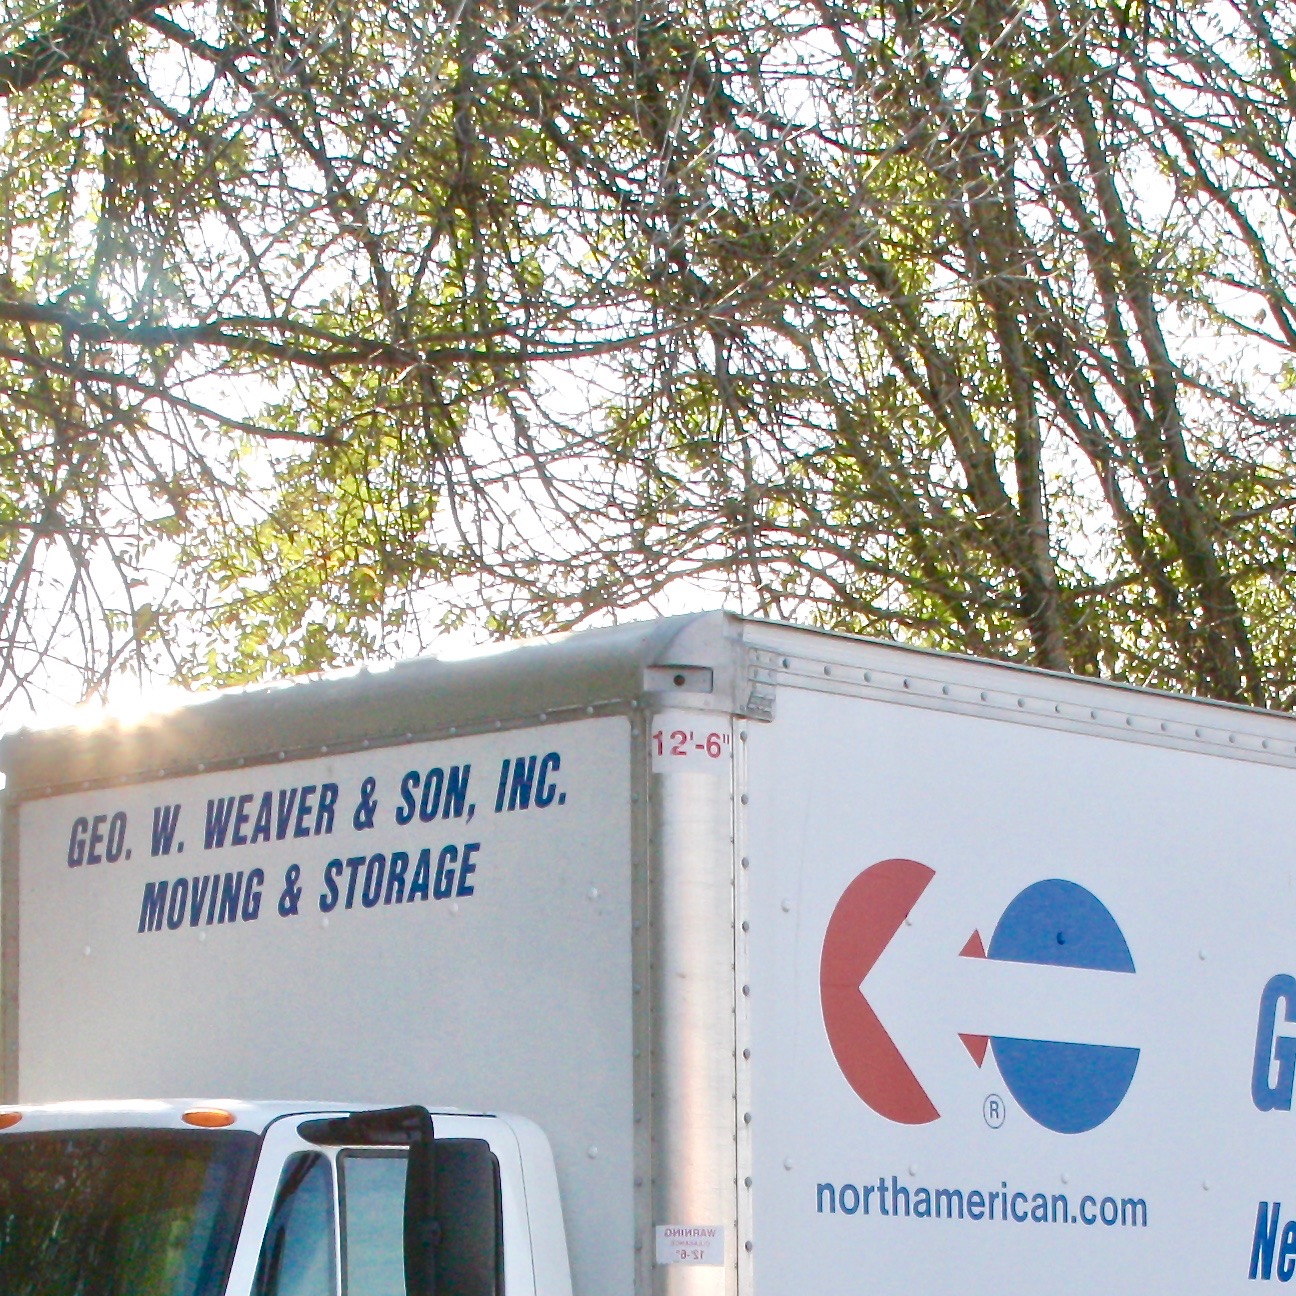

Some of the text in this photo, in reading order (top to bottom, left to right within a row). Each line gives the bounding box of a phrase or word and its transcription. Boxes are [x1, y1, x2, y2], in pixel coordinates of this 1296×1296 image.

[652, 730, 730, 759] 12'-6"
[67, 751, 567, 869] GEO. W. WEAVER & SON, INC.
[137, 841, 481, 934] MOVING & STORAGE
[815, 1175, 1148, 1228] northamerican.com
